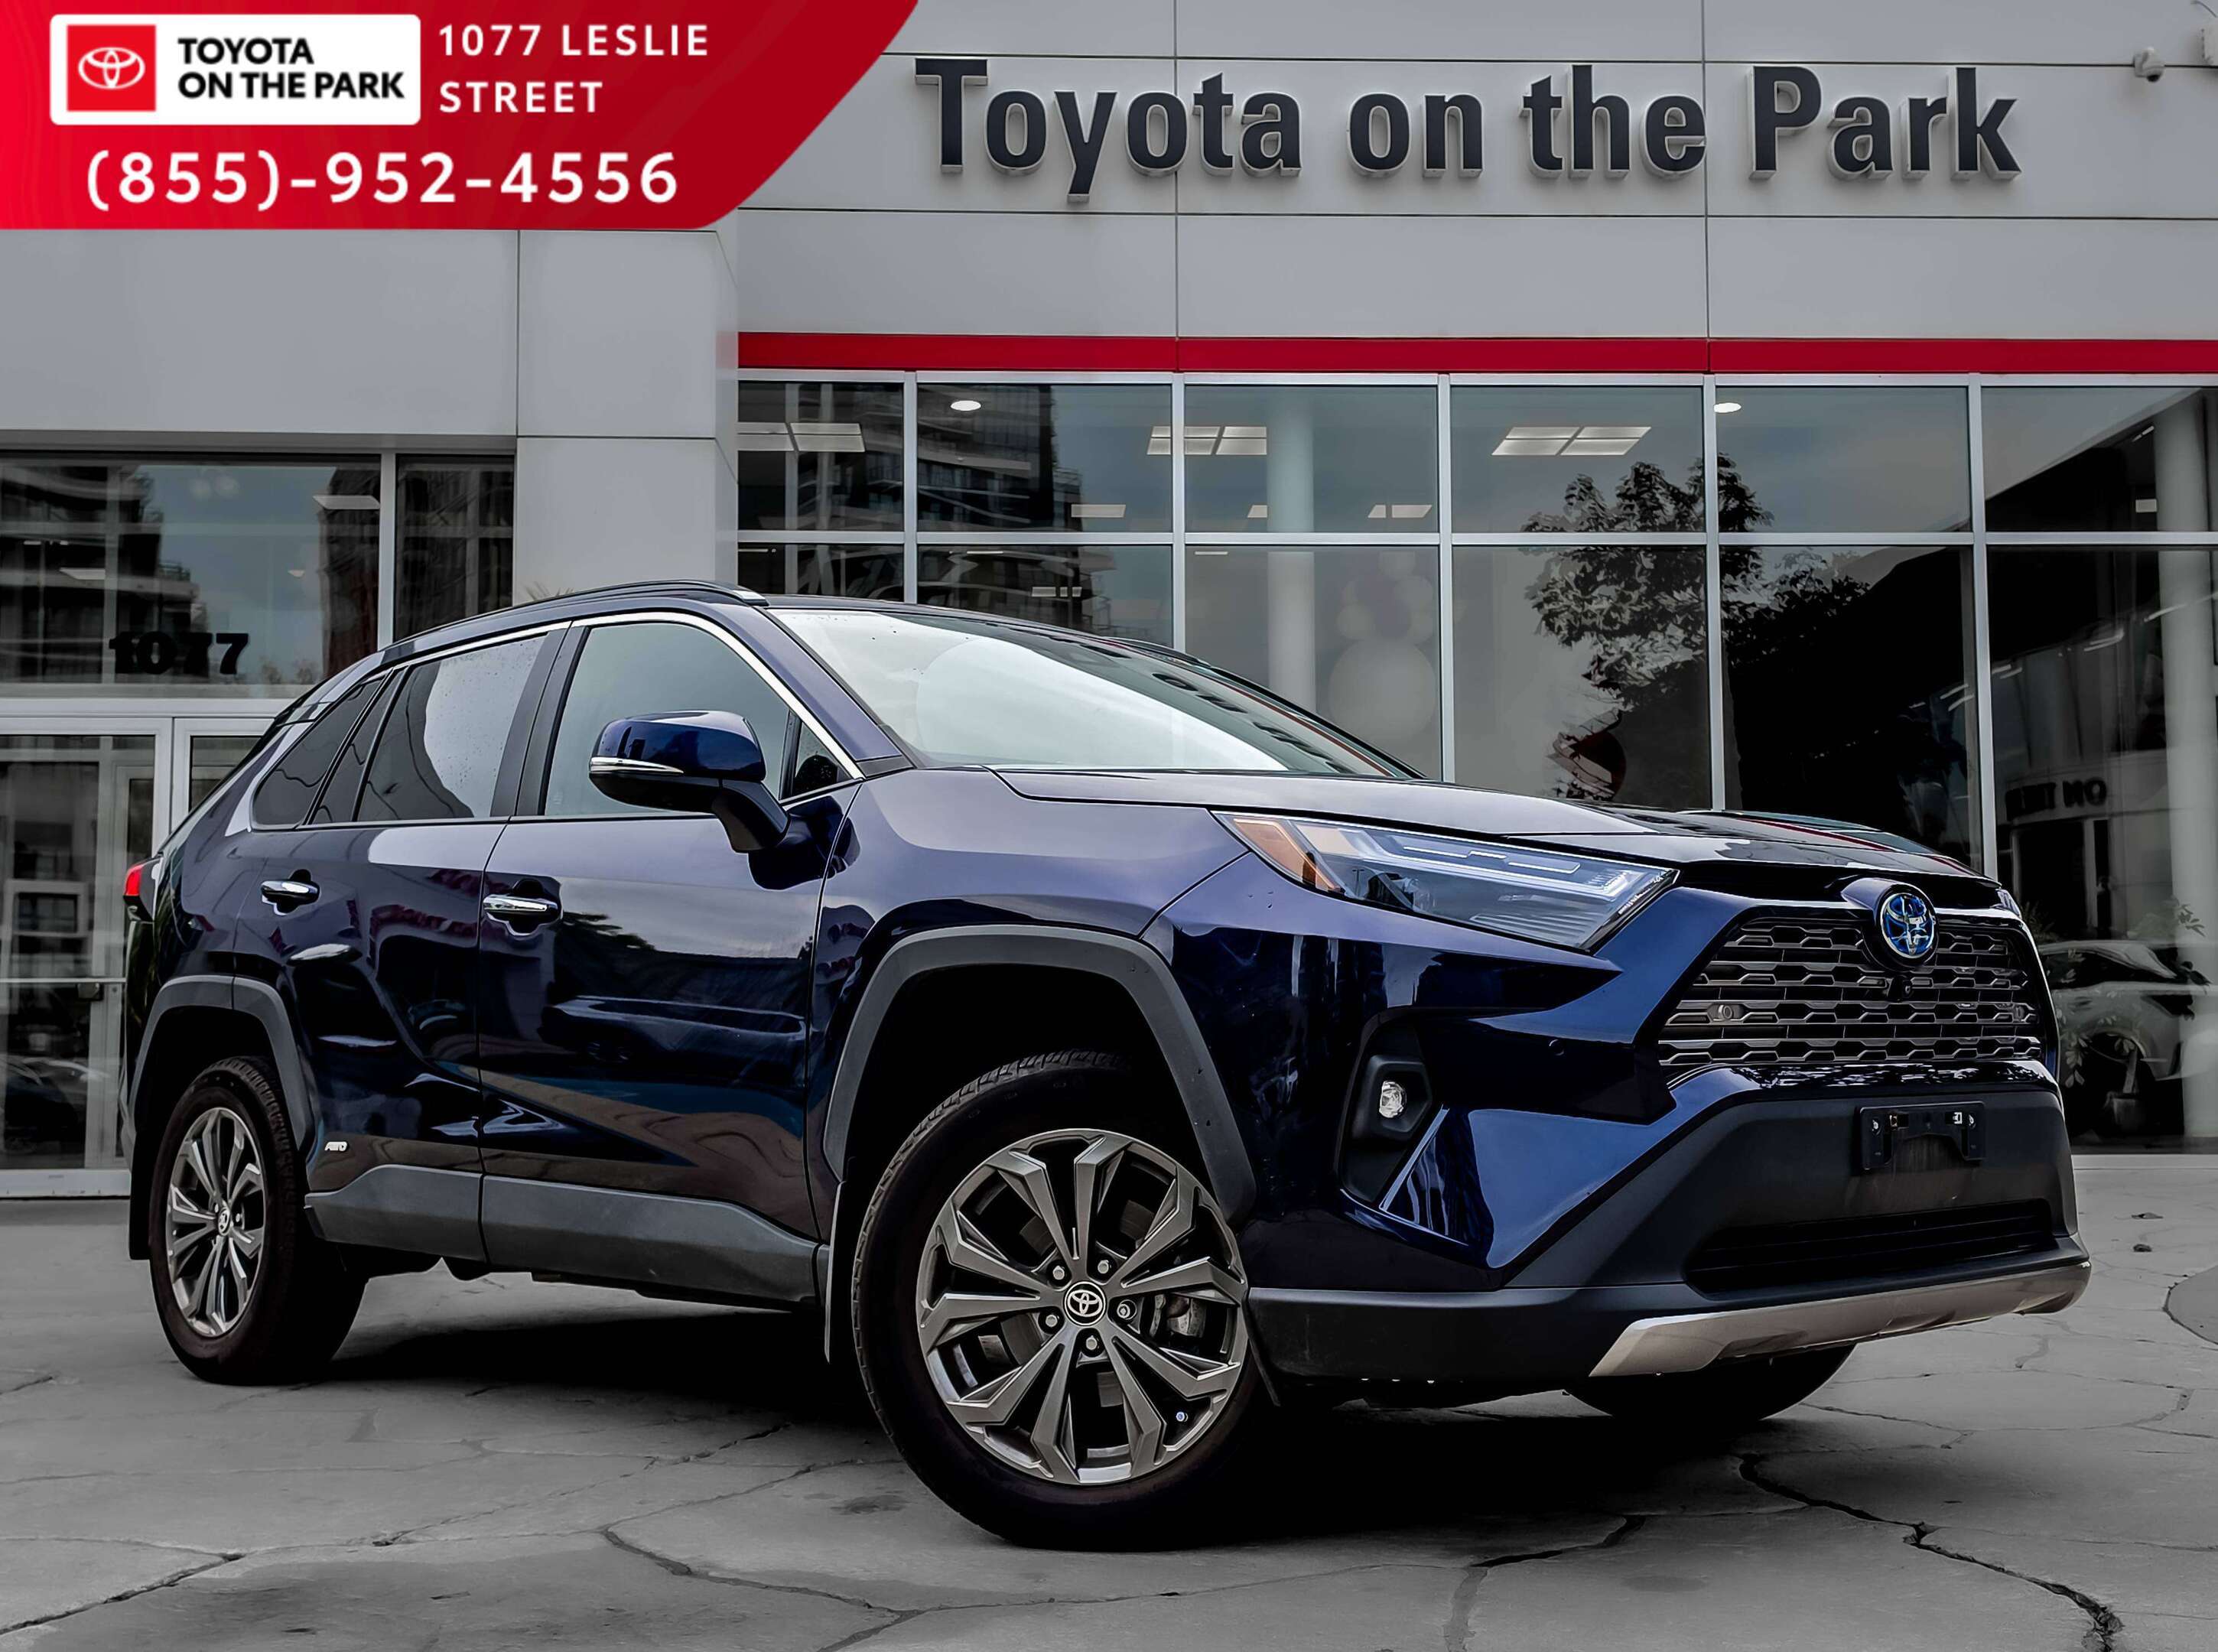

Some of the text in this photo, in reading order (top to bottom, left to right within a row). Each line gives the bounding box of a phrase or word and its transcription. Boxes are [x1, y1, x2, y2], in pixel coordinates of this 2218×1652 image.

[915, 57, 2021, 200] Toyota on the Park
[109, 631, 249, 675] 1077
